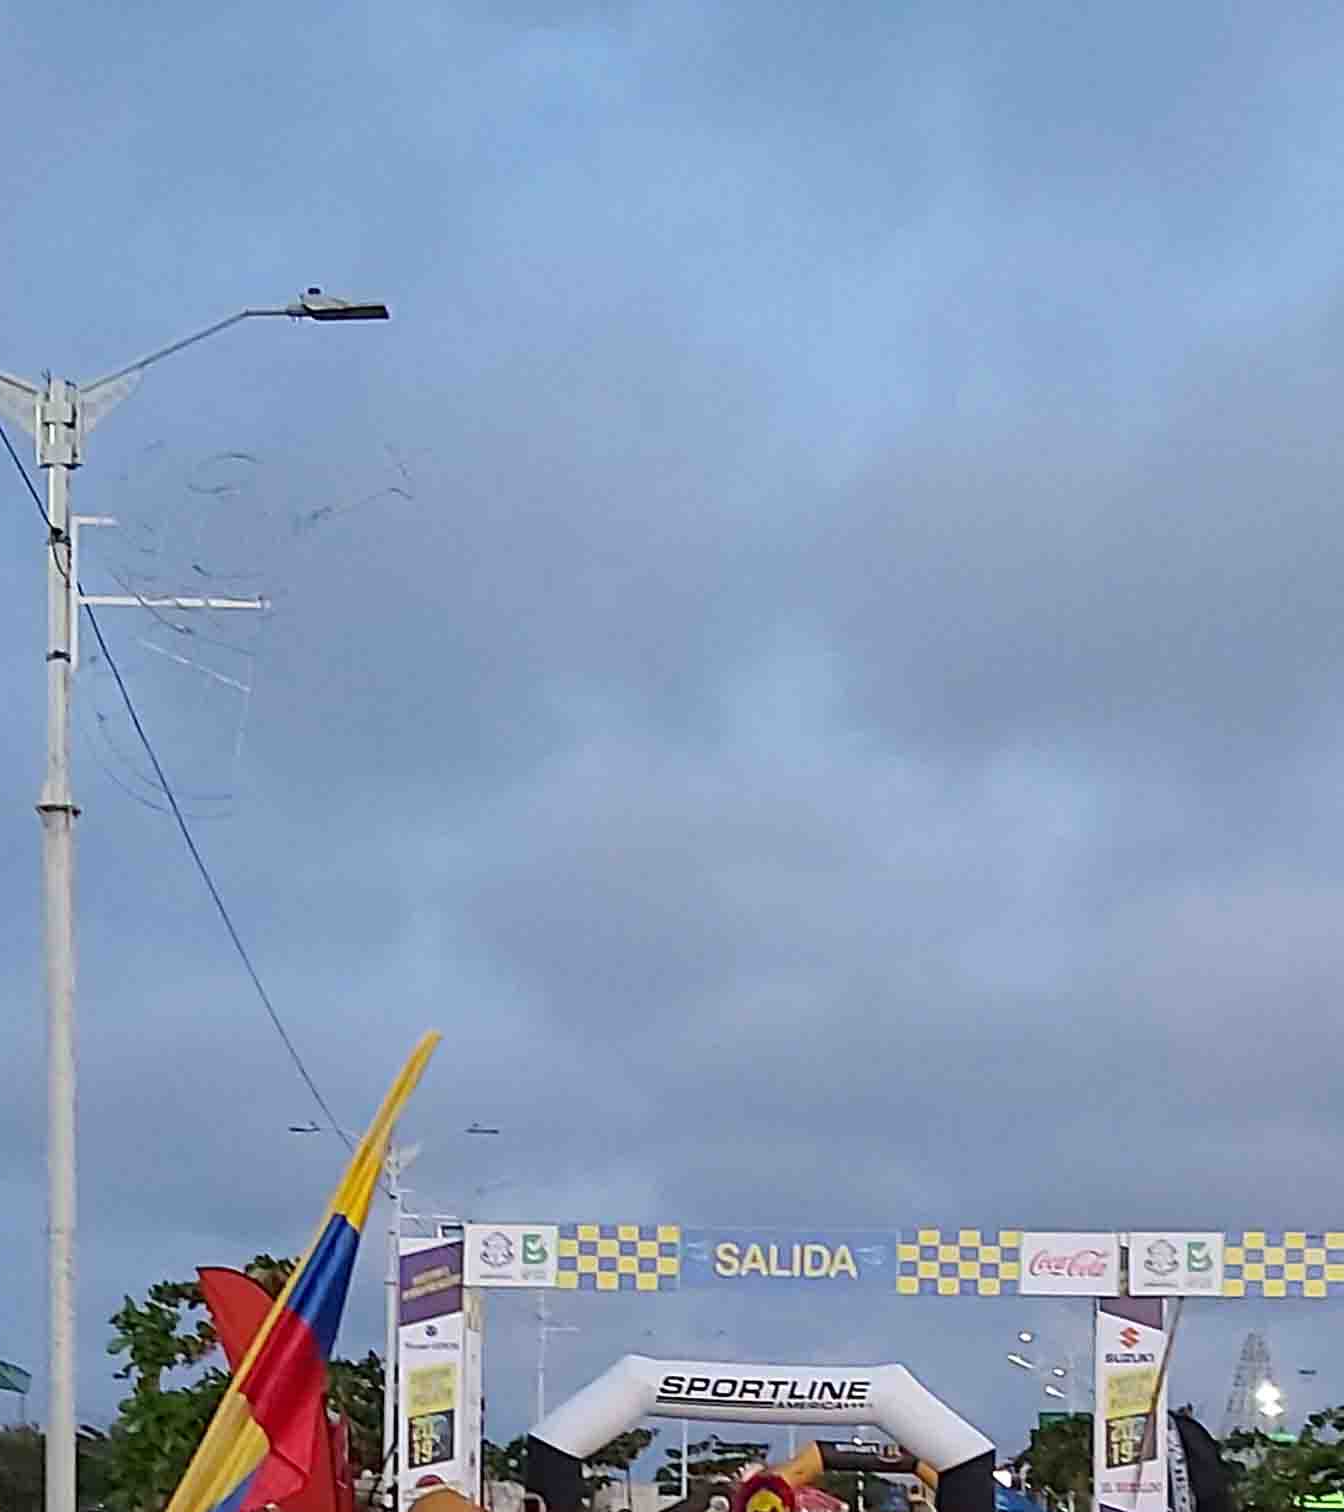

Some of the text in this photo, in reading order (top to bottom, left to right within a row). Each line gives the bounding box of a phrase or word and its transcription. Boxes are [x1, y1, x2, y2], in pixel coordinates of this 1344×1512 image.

[714, 1243, 858, 1278] SALIDA
[1105, 1353, 1154, 1363] SUZUKI
[658, 1375, 870, 1400] SPORTLINE
